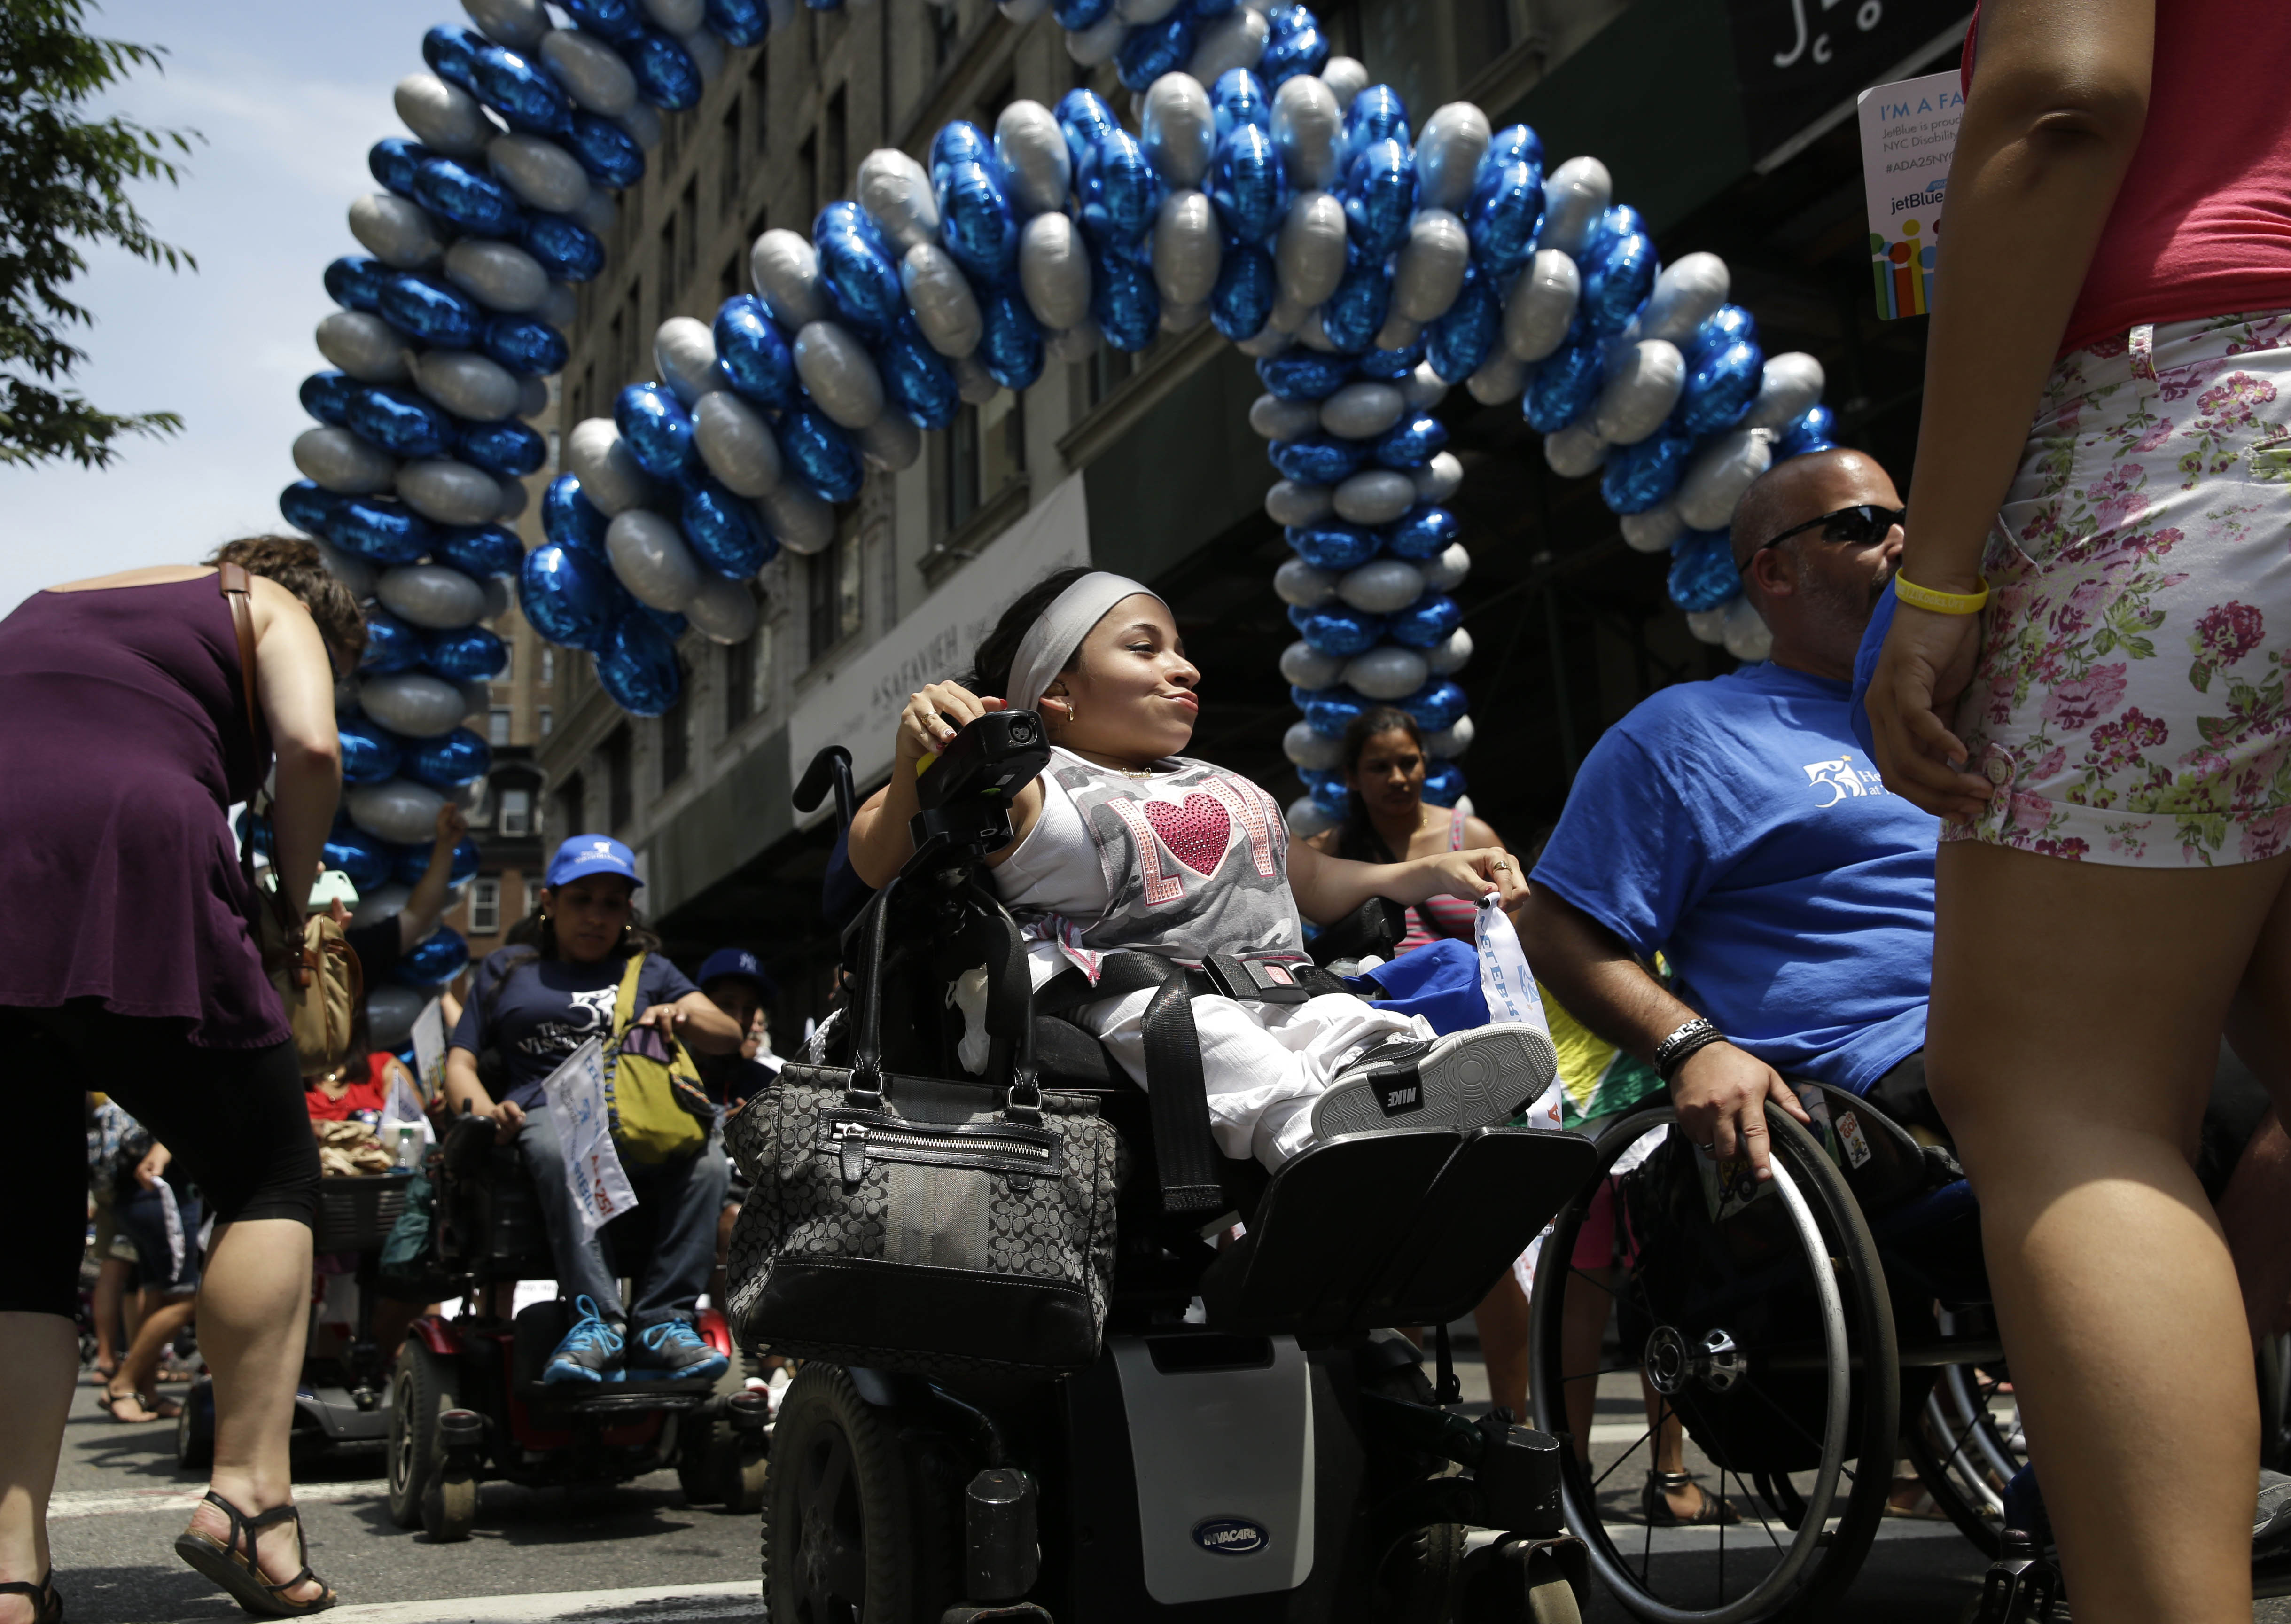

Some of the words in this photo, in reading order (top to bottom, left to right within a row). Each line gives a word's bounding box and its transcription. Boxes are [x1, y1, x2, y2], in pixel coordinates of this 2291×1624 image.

[1881, 102, 1910, 121] I'M
[1917, 97, 1933, 114] A
[1883, 125, 1917, 139] JetBlue
[1920, 121, 1928, 132] is
[1883, 139, 1909, 153] NYC
[1891, 192, 1944, 215] jetBlue
[1868, 785, 1883, 796] at
[536, 1021, 569, 1037] The
[516, 1031, 607, 1054] Viscar
[1387, 1087, 1416, 1108] NIKE
[1203, 1528, 1257, 1546] INVACARE
